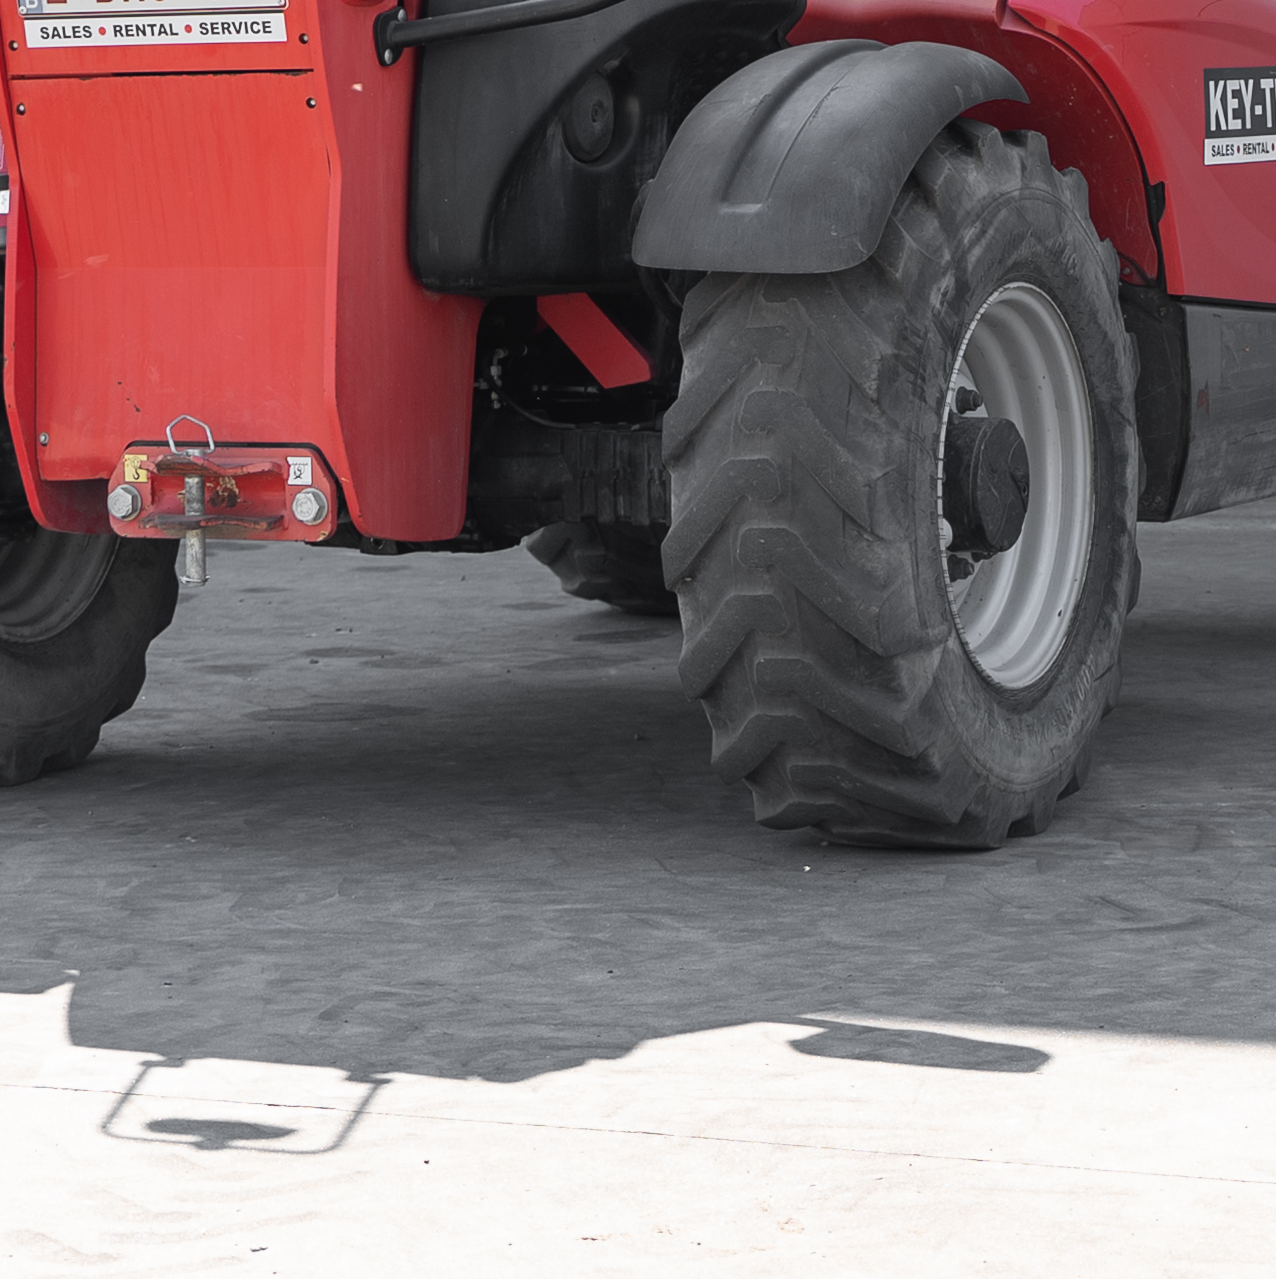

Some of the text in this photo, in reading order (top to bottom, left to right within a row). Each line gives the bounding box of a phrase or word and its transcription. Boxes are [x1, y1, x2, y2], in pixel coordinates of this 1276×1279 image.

[40, 21, 272, 40] SALES RENTAL SERVICE
[1211, 144, 1235, 157] SALES
[1242, 142, 1270, 156] RENTAL
